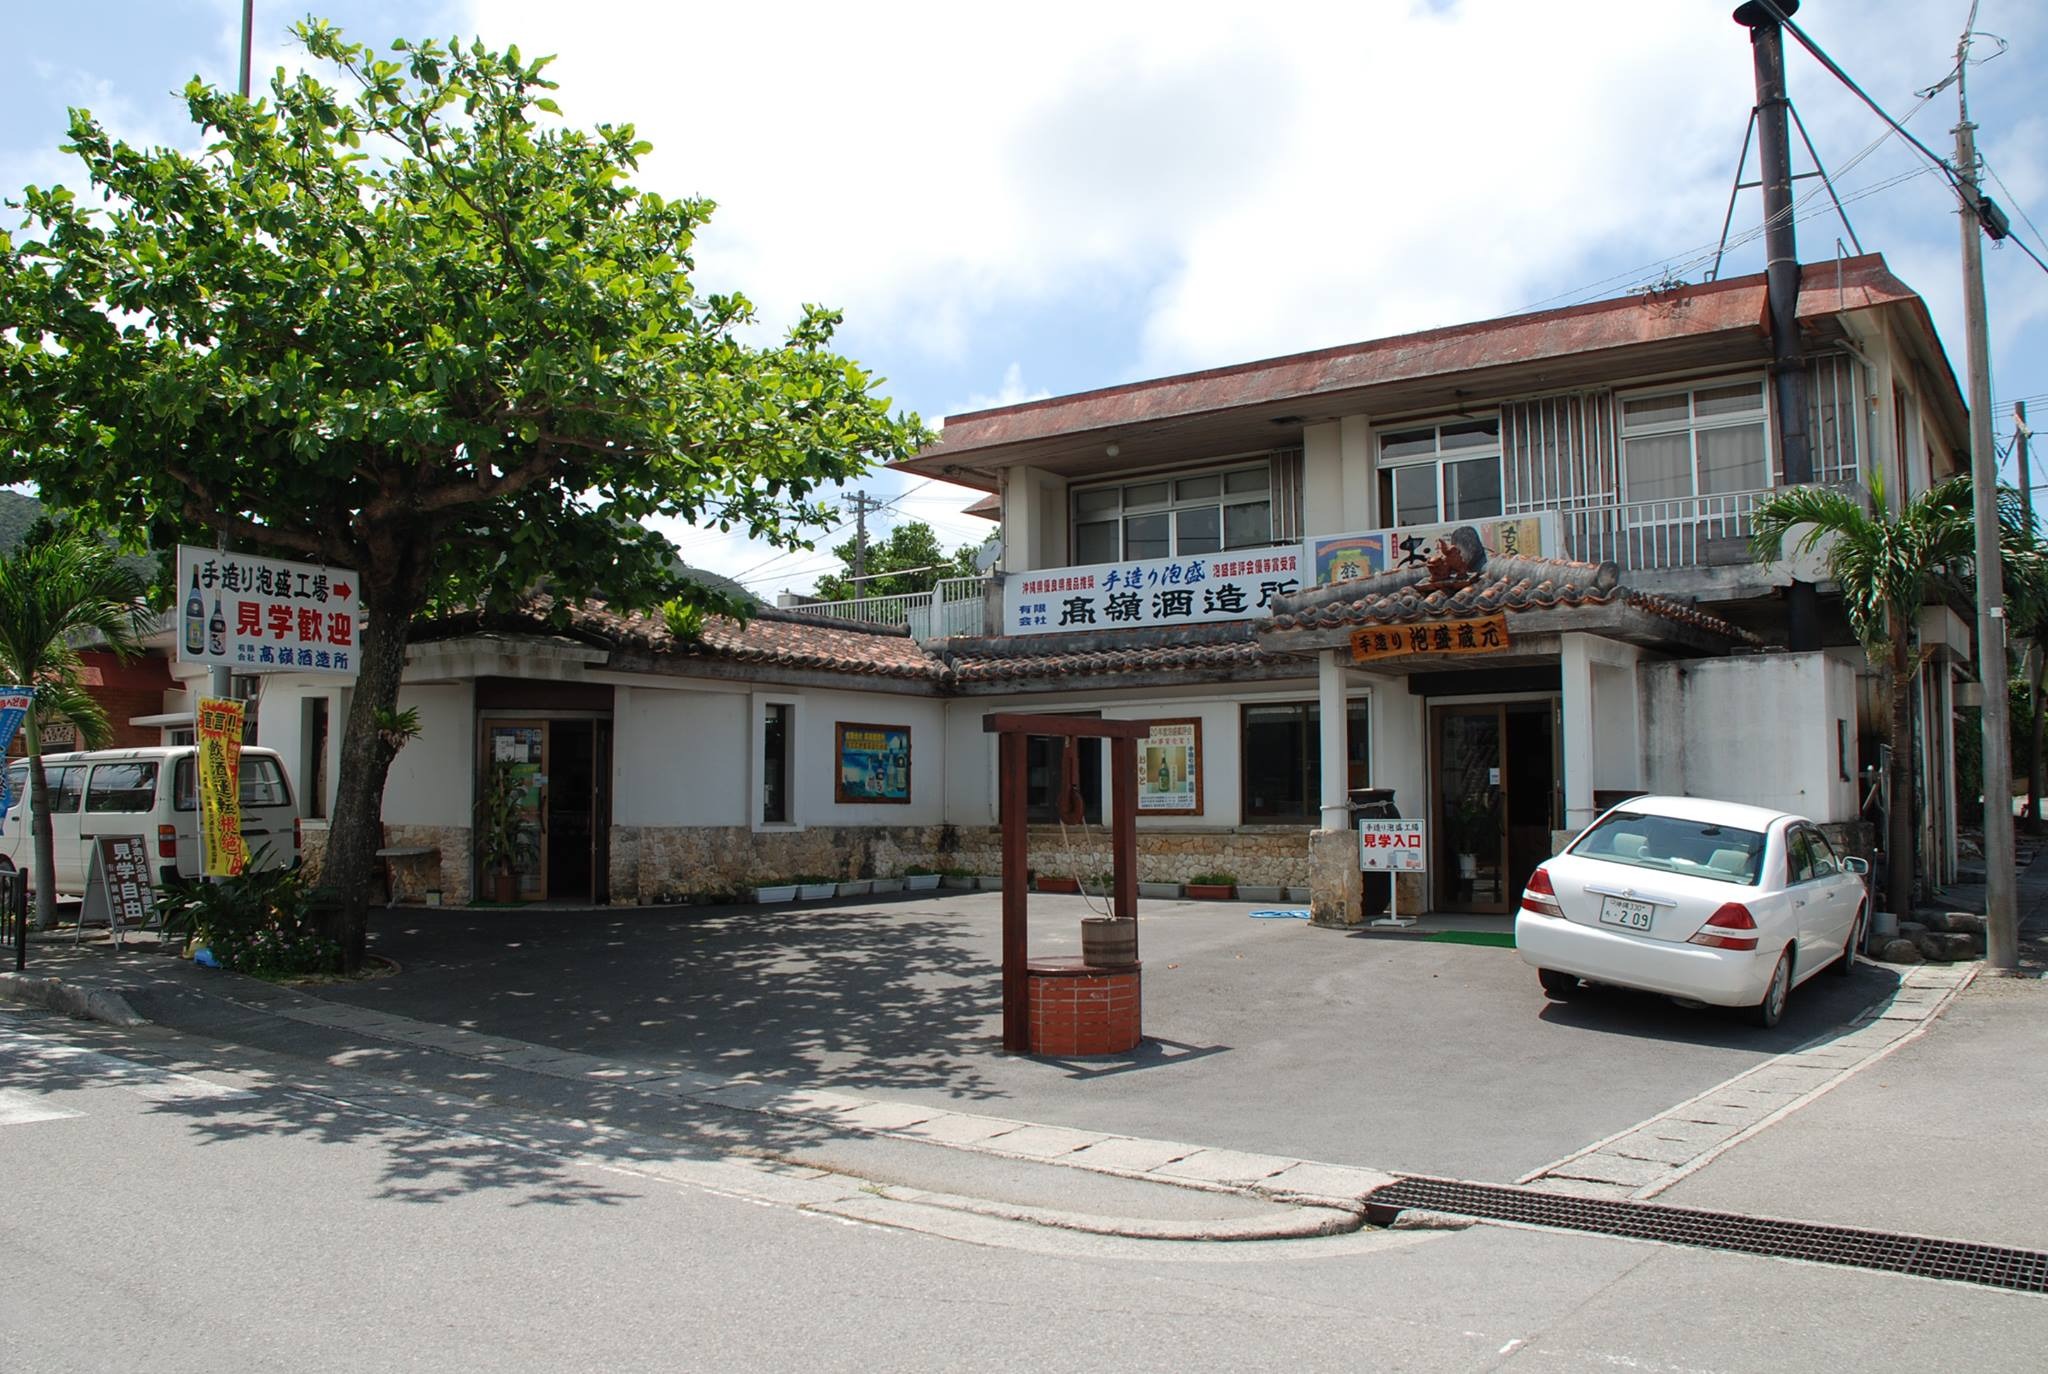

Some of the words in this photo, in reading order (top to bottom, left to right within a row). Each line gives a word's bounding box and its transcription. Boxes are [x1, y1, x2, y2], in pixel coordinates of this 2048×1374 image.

[201, 559, 330, 603] 手造り泡盛工場
[1101, 560, 1205, 592] 手造り泡盛
[236, 601, 352, 647] 見学歓迎
[1364, 834, 1421, 848] 見学入口
[113, 843, 143, 919] 見学自由
